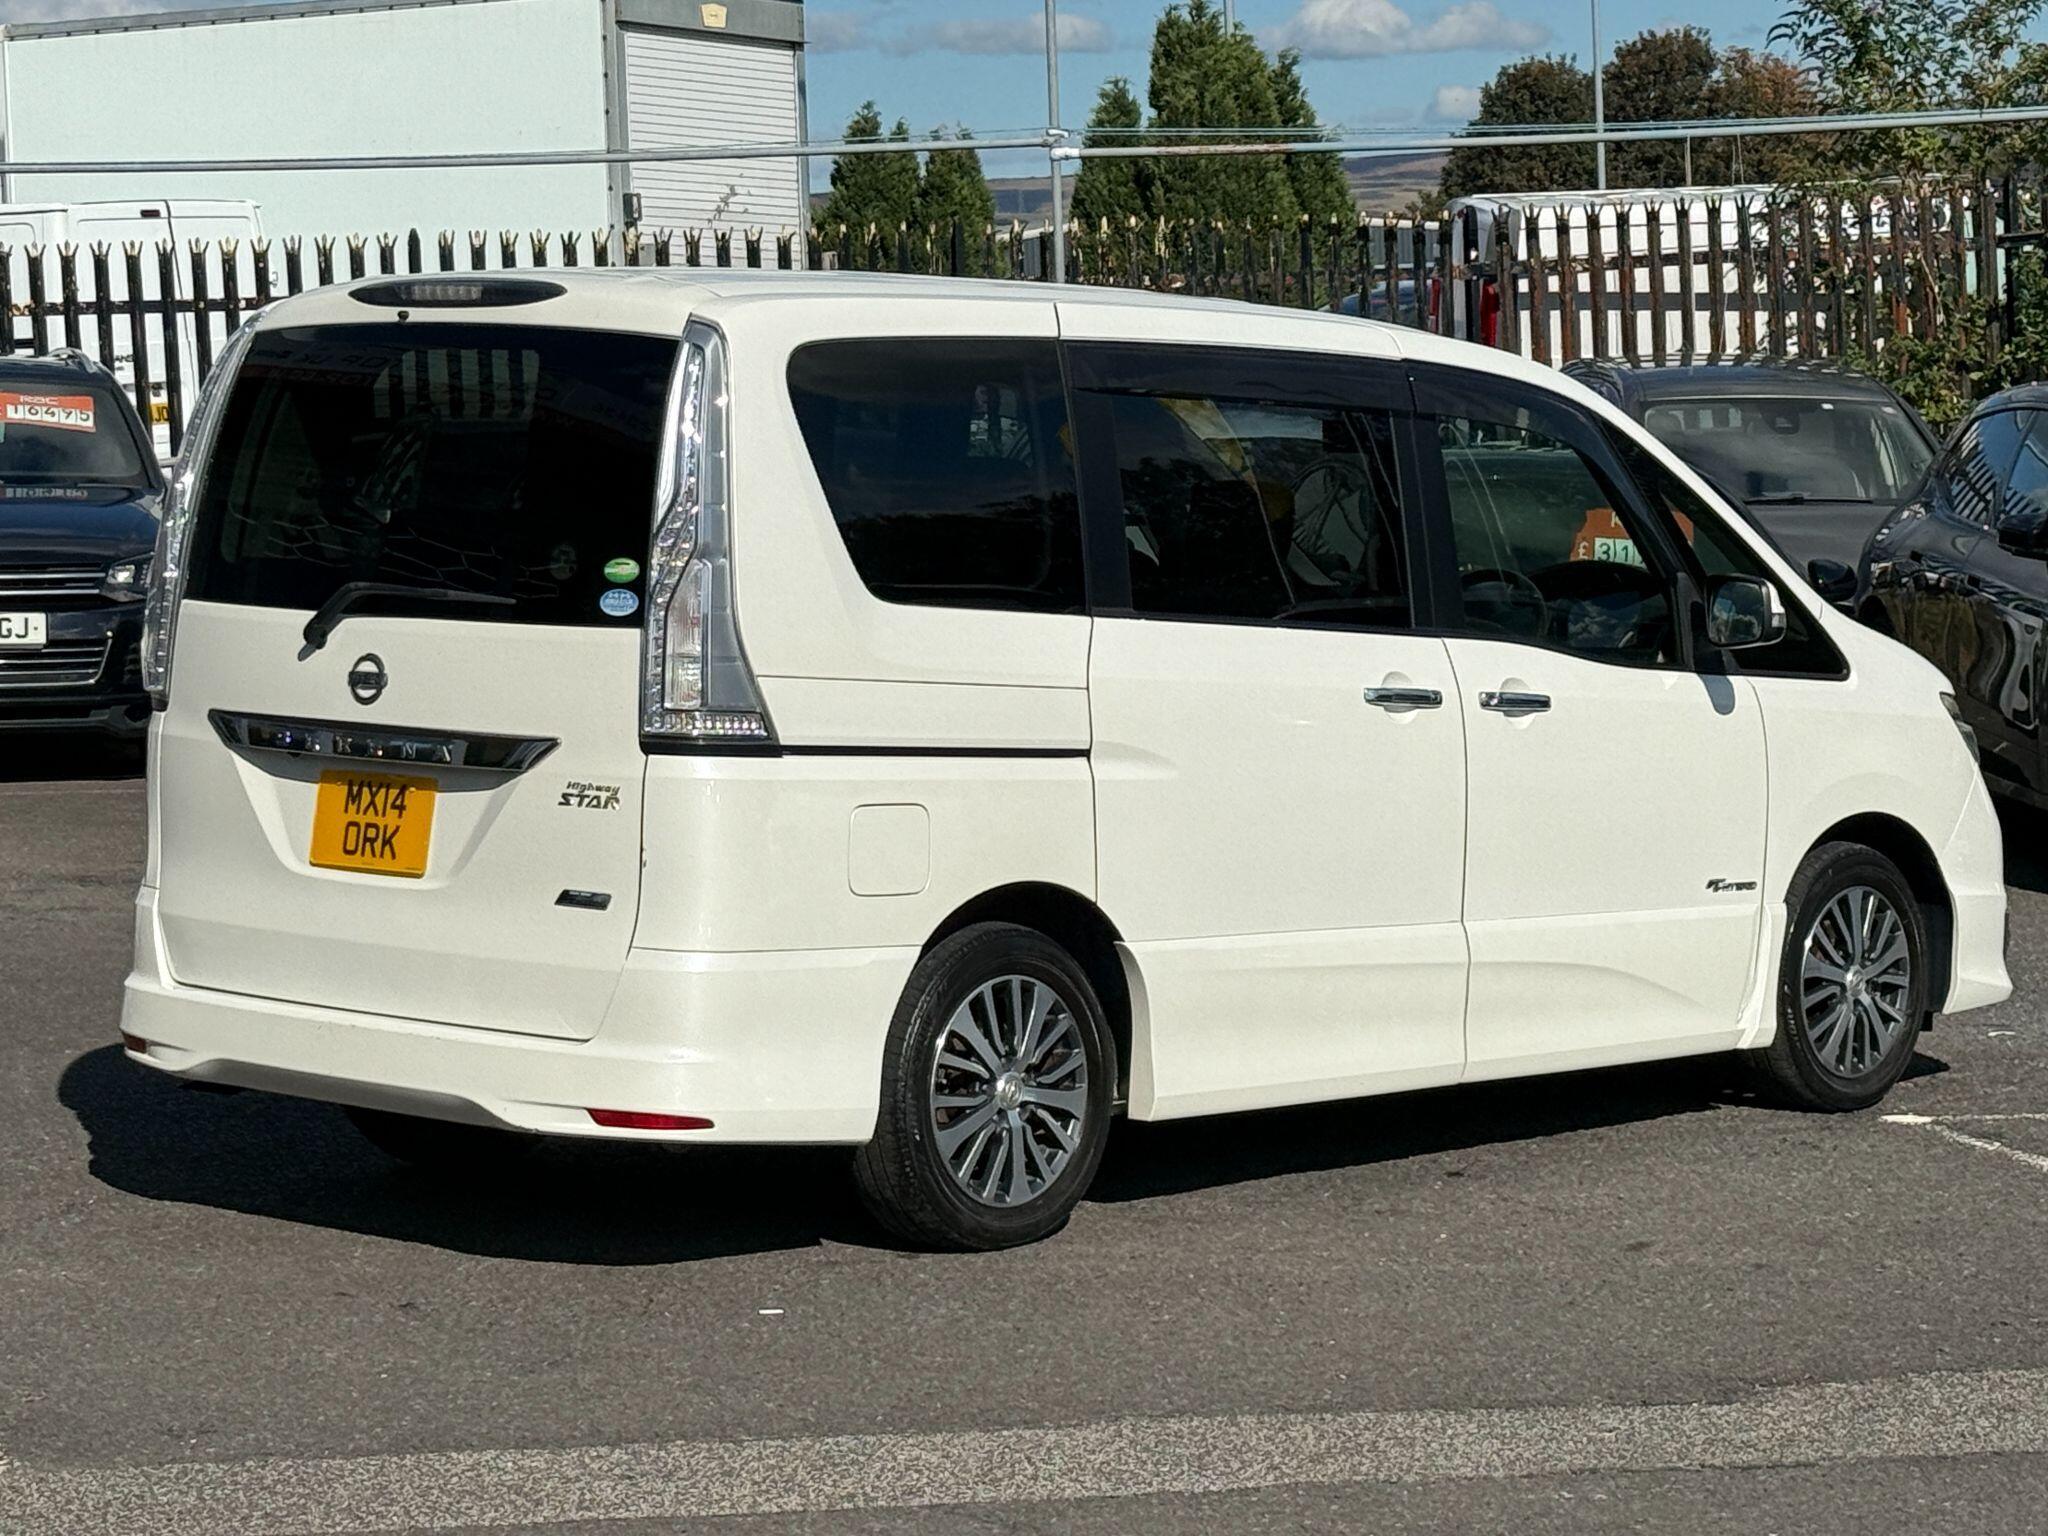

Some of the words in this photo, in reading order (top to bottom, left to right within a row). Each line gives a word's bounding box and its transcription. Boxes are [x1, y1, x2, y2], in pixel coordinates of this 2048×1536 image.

[344, 779, 407, 819] MX14
[558, 792, 620, 810] STAR
[342, 820, 400, 861] ORK
